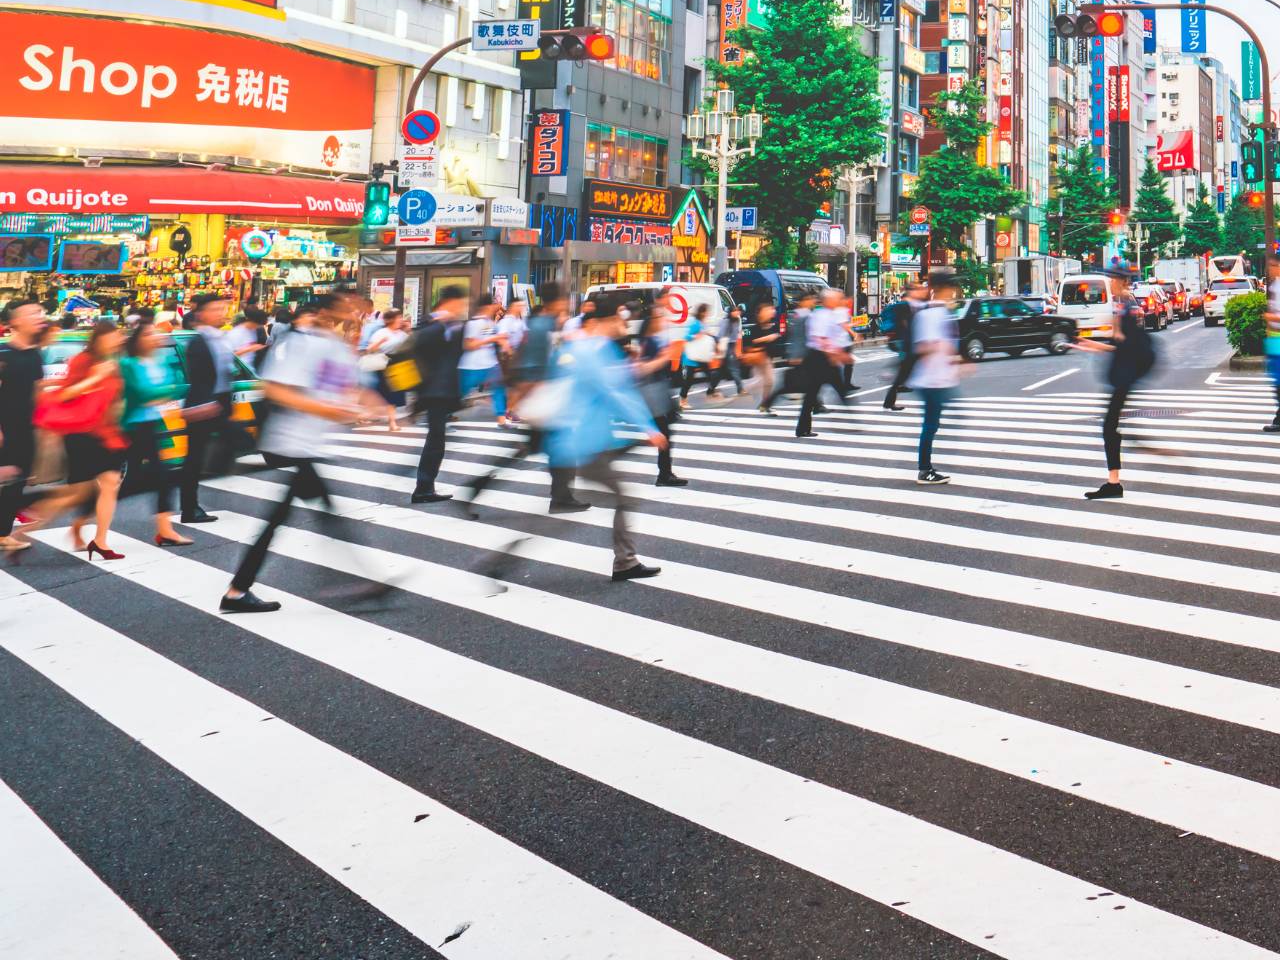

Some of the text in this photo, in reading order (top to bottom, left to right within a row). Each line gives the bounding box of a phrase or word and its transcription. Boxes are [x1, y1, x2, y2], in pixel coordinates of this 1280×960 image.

[478, 24, 534, 38] 歌舞伎町
[488, 38, 523, 46] Kabukicho
[18, 43, 290, 113] Shop 免税店
[539, 127, 557, 174] ダイコク
[27, 189, 129, 209] Quijote
[306, 196, 366, 216] Don Quijo
[406, 198, 420, 219] P
[604, 221, 644, 243] ダイコク
